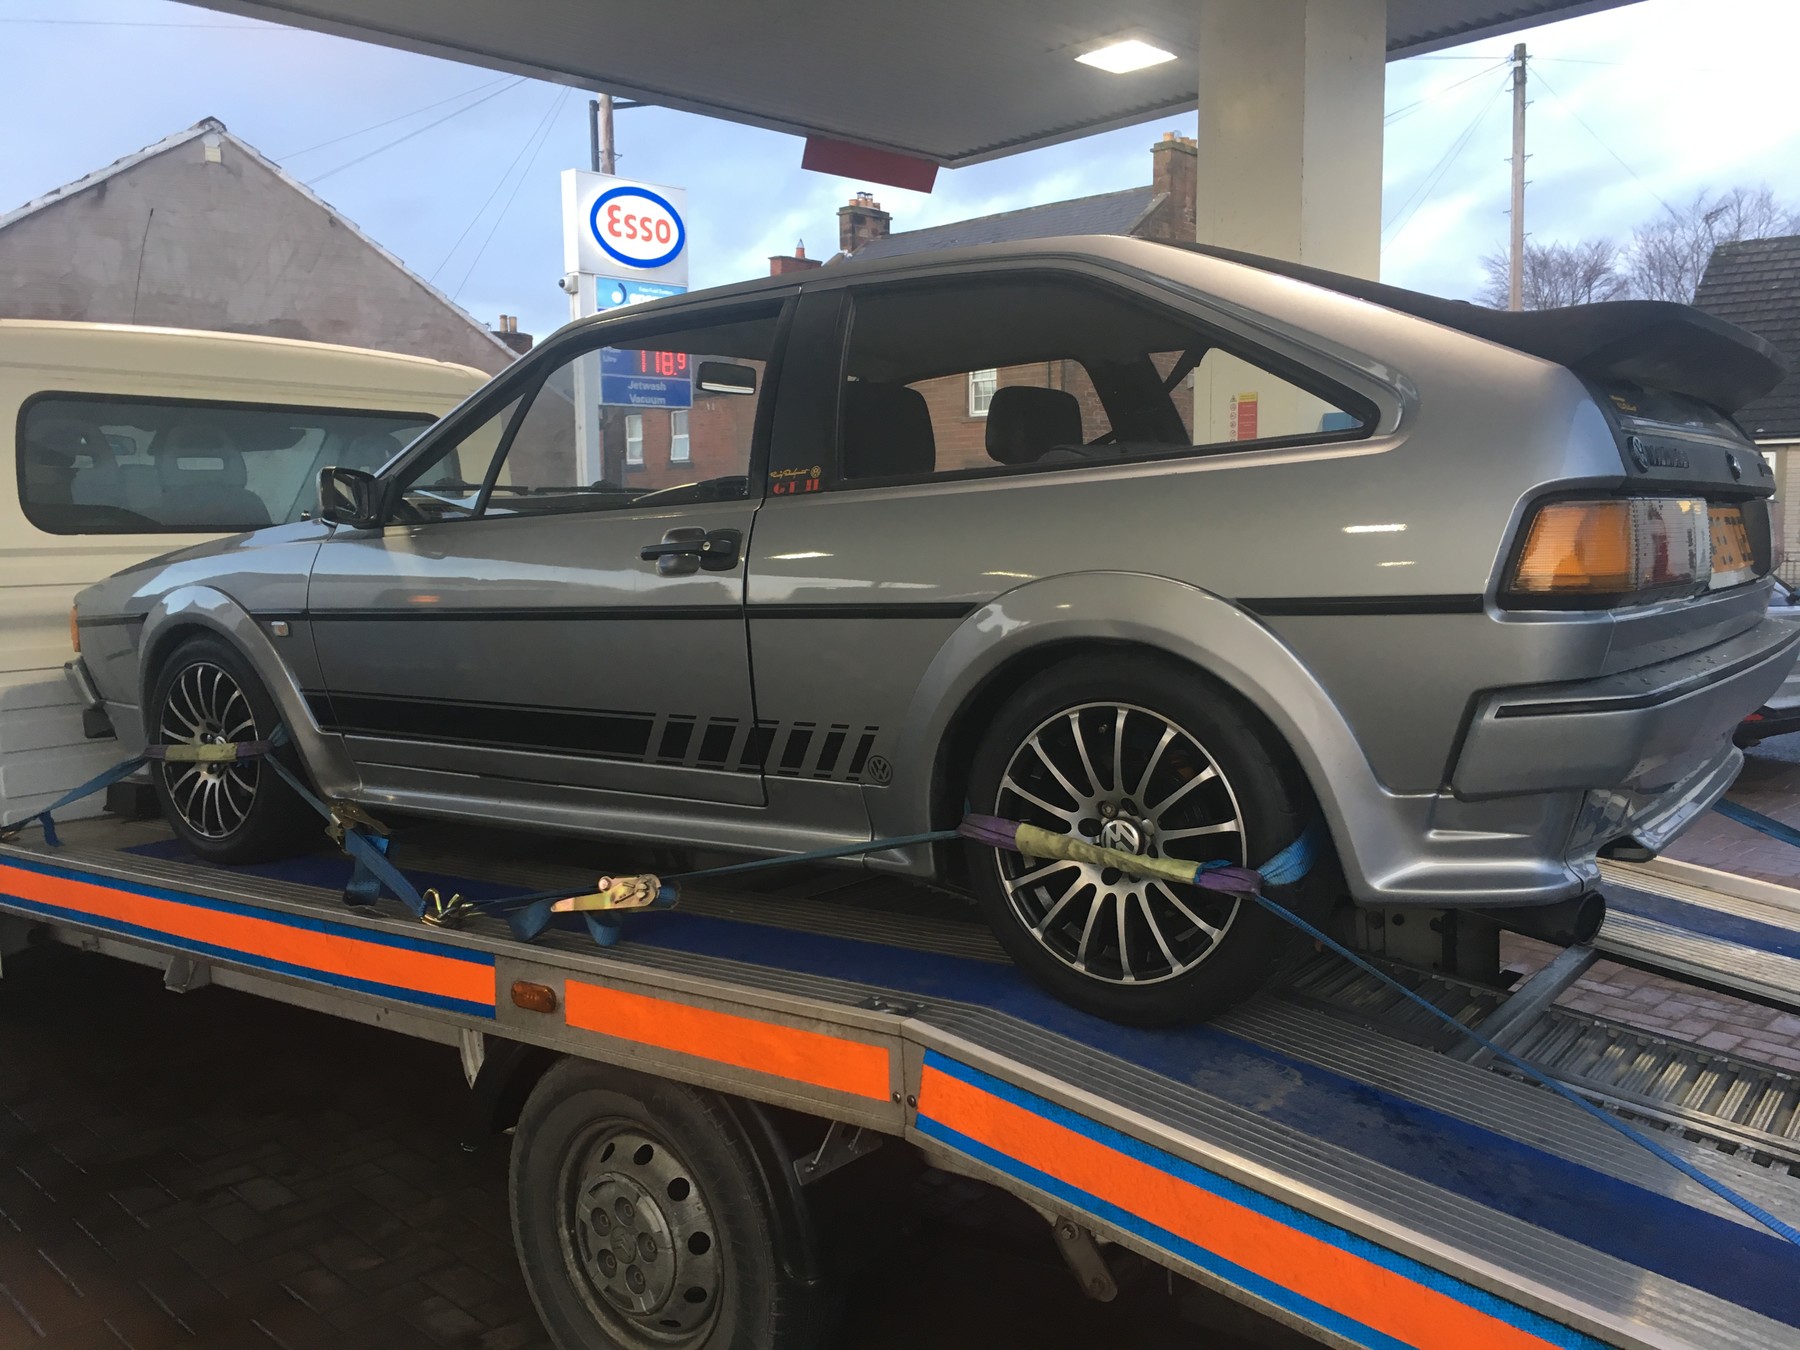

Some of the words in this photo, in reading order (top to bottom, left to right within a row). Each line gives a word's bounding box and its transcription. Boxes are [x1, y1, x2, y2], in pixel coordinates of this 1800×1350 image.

[607, 204, 671, 244] Esso
[627, 381, 667, 391] Jetwash
[628, 394, 666, 405] Vacuum
